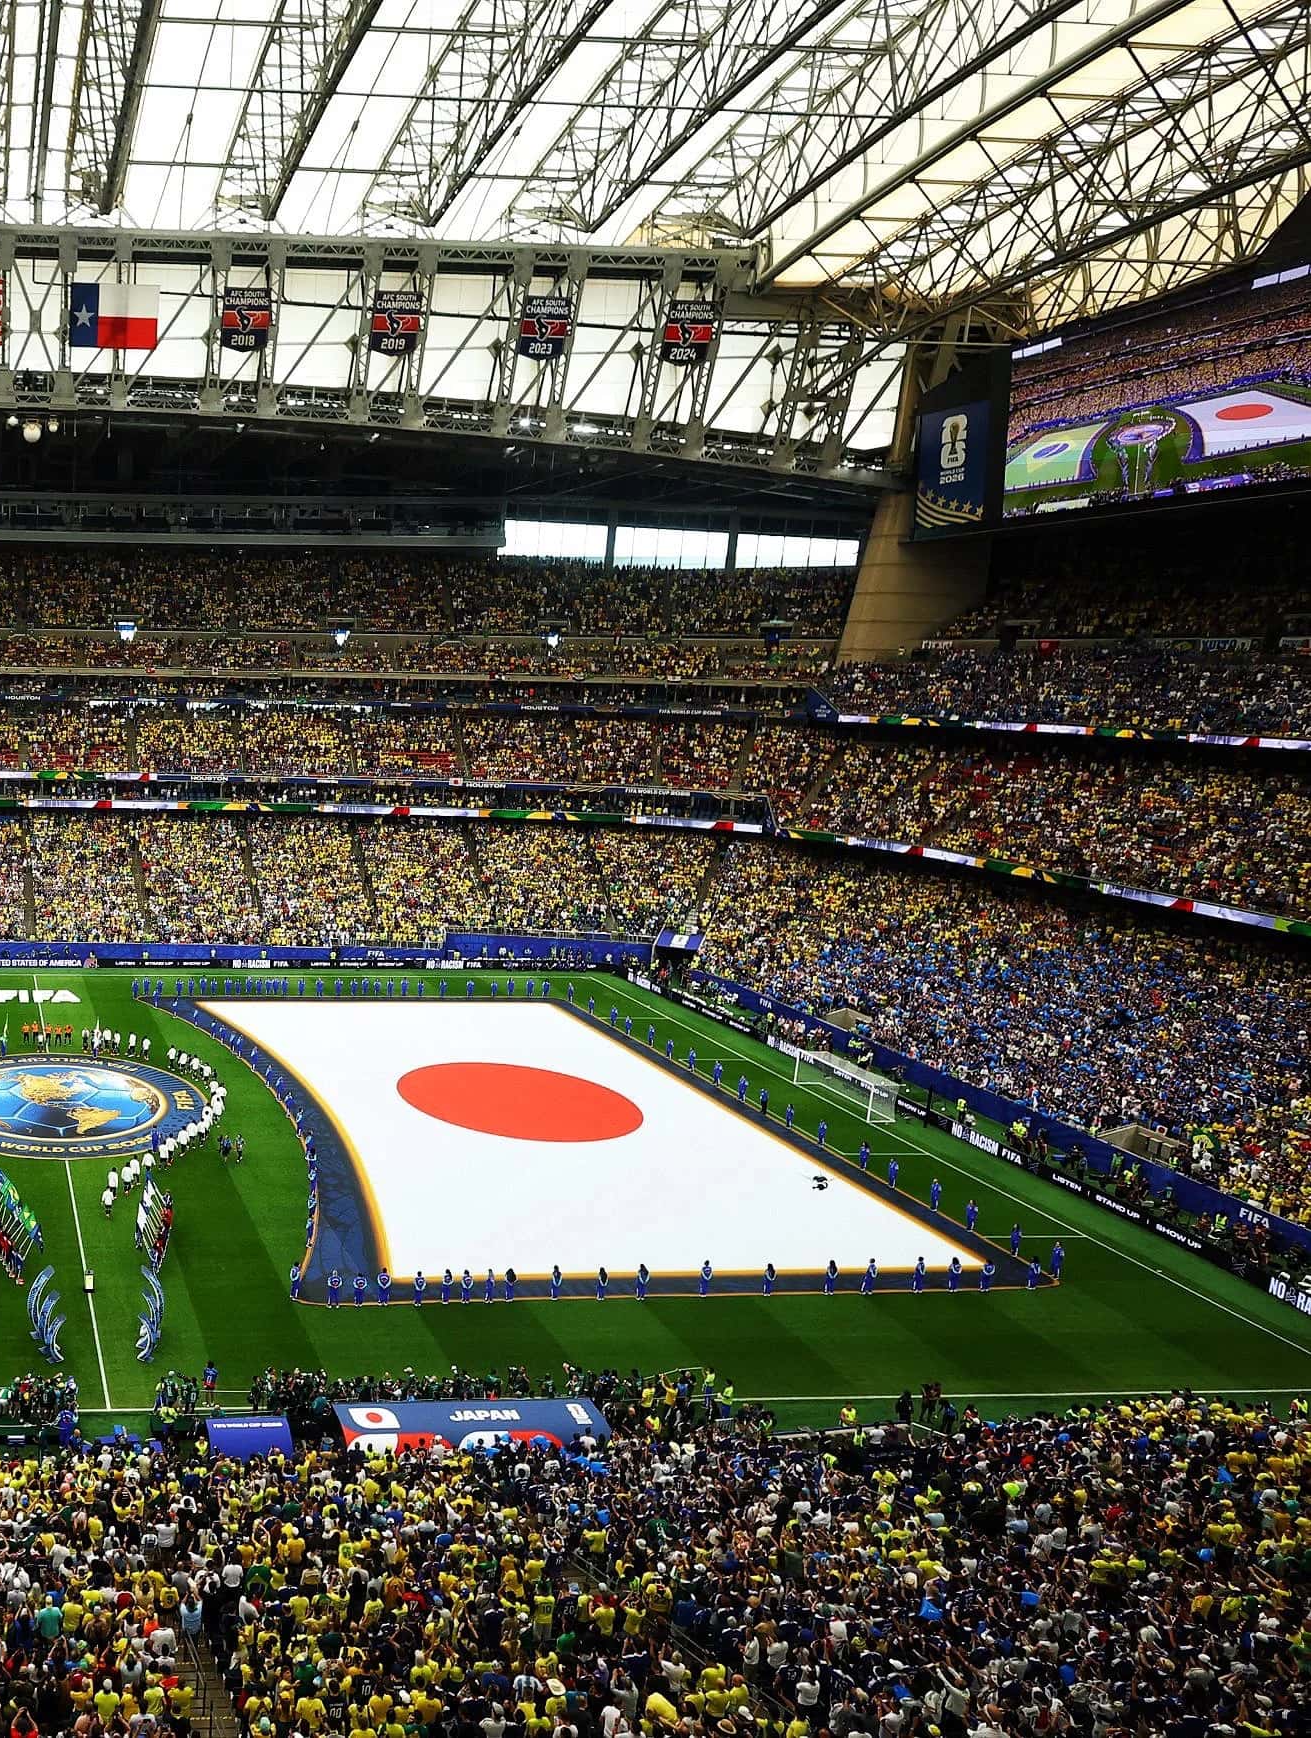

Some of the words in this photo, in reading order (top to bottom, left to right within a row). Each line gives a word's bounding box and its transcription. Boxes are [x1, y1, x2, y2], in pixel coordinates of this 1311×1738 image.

[230, 290, 242, 298] AFC
[244, 290, 266, 299] SOUTH
[382, 293, 394, 302] AFC
[395, 293, 418, 302] SOUTH
[225, 296, 270, 307] CHAMPIONS
[376, 300, 421, 311] CHAMPIONS
[532, 298, 543, 307] AFC
[545, 298, 567, 308] SOUTH
[526, 304, 569, 316] CHAMPIONS
[676, 303, 687, 312] AFC
[689, 303, 711, 313] SOUTH
[669, 309, 713, 322] CHAMPIONS
[230, 334, 255, 346] 2018
[380, 337, 406, 350] 2019
[528, 341, 553, 355] 2023
[669, 348, 697, 361] 2024
[367, 949, 385, 958] FIFA
[11, 959, 38, 967] STATES
[39, 959, 49, 967] OF
[49, 959, 82, 967] AMERICA
[232, 959, 241, 969] NO
[247, 959, 271, 969] RACISM
[425, 960, 434, 970] NO
[440, 960, 464, 970] RACISM
[759, 997, 772, 1010] FIFA
[767, 1035, 776, 1048] NO
[22, 1056, 48, 1064] CUP
[171, 1090, 195, 1110] FIFA
[897, 1099, 917, 1113] SHOW
[916, 1108, 926, 1116] UP
[0, 1141, 65, 1154] WORLD
[68, 1144, 104, 1154] CUP
[951, 1121, 962, 1138] NO
[969, 1128, 999, 1156] RACISM
[1001, 1146, 1023, 1165] FIFA
[1052, 1172, 1082, 1192] LISTEN
[1095, 1193, 1126, 1214] STAND
[1125, 1207, 1141, 1219] UP
[1155, 1222, 1188, 1244] SHOW
[1186, 1237, 1202, 1249] UP
[1239, 1206, 1270, 1230] FIFA
[1269, 1276, 1286, 1300] NO
[448, 1408, 520, 1423] JAPAN
[564, 1605, 575, 1616] 20
[361, 1684, 371, 1696] 10
